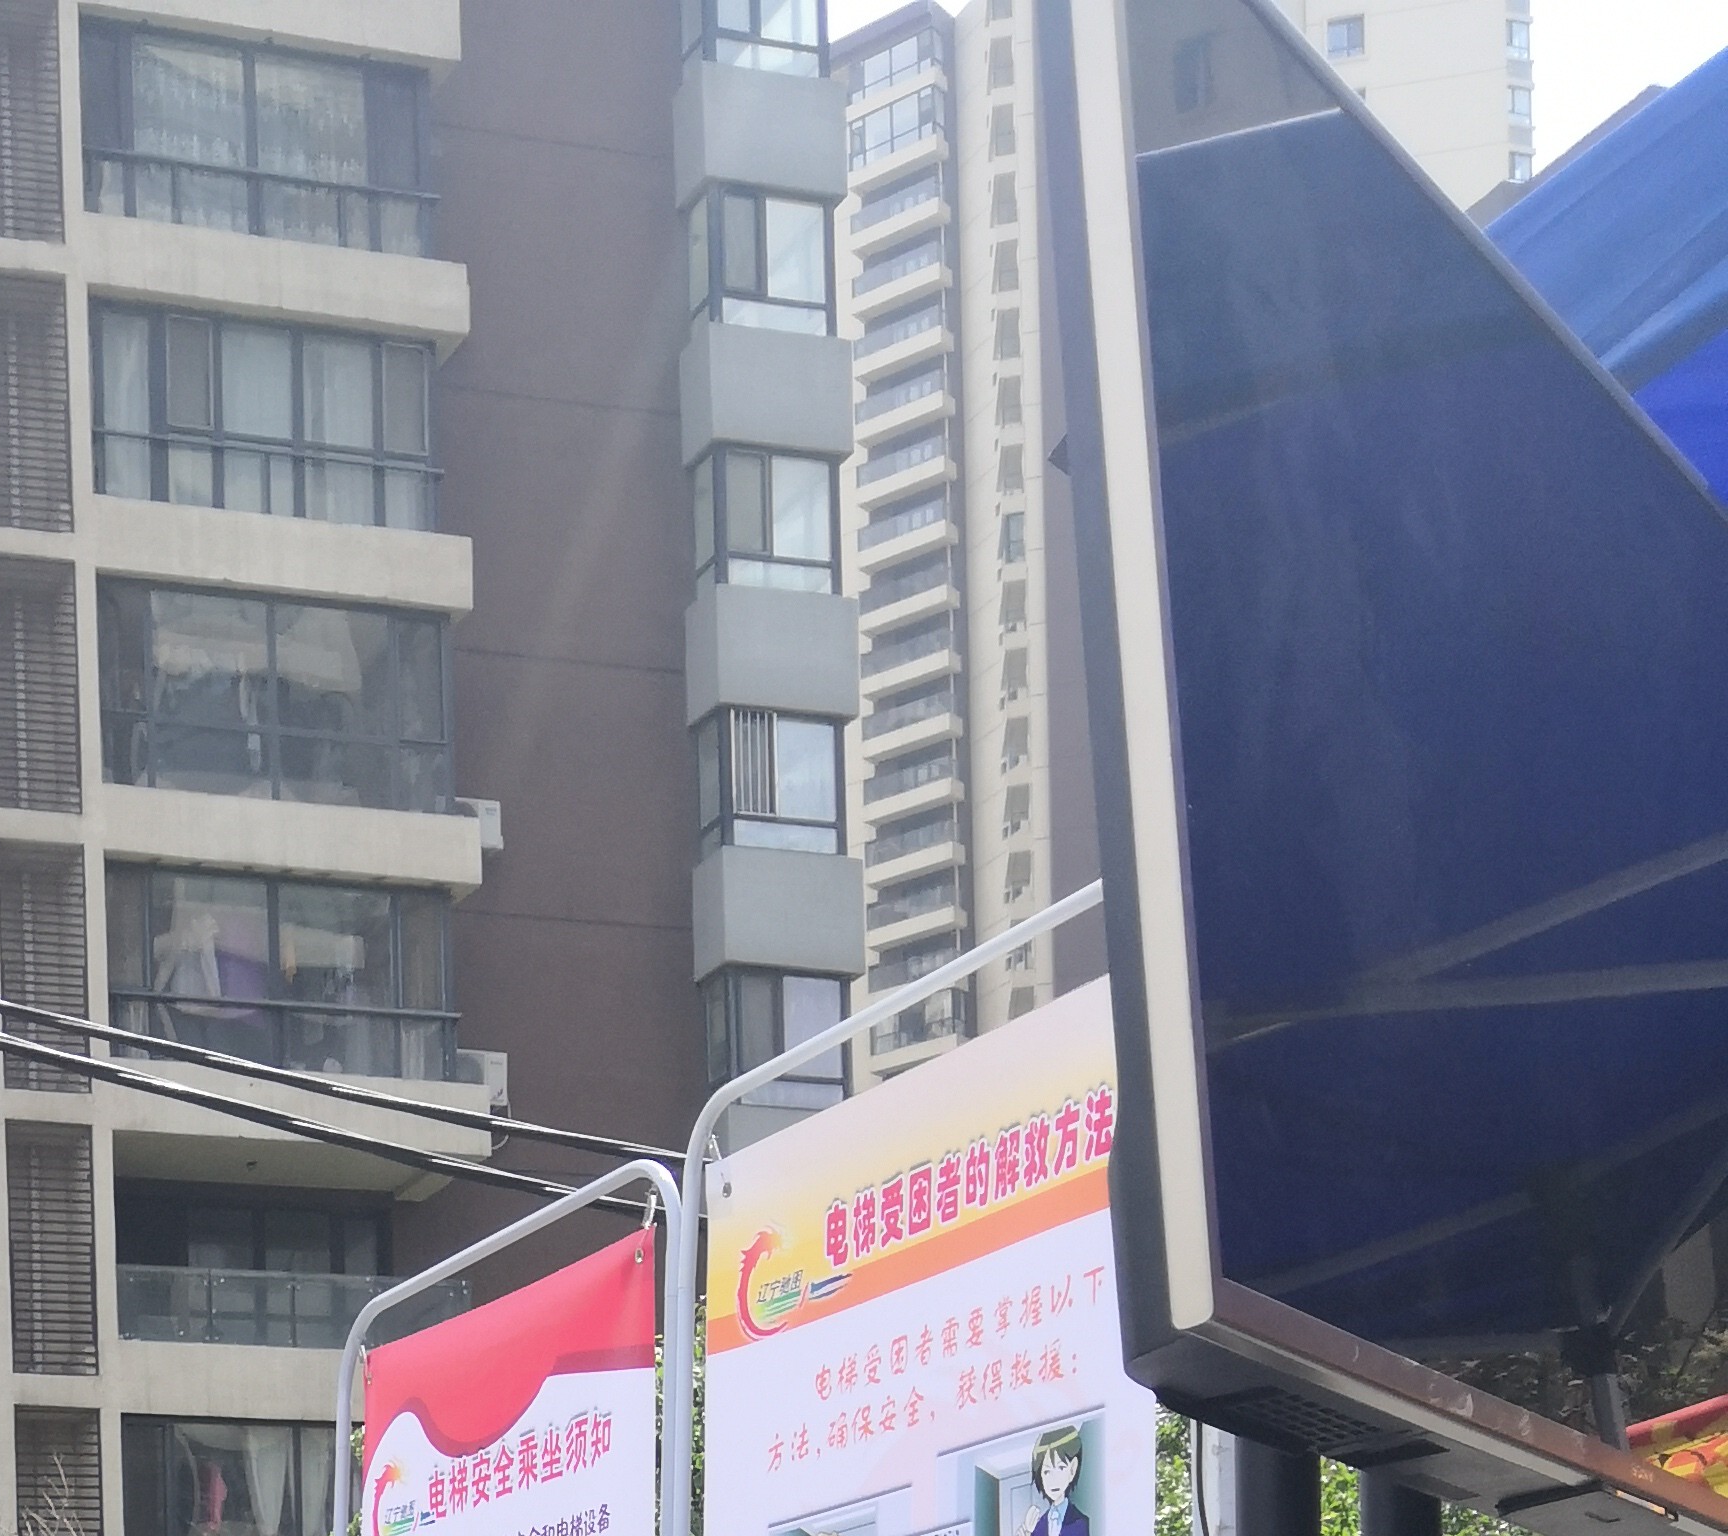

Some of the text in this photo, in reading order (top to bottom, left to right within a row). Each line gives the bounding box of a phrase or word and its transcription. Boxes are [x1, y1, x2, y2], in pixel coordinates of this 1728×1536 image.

[824, 1087, 1114, 1266] 电梯受困者的解救方法
[815, 1265, 1105, 1400] 电梯受困者需要掌握以下
[428, 1411, 613, 1518] 电梯安全乘坐须知
